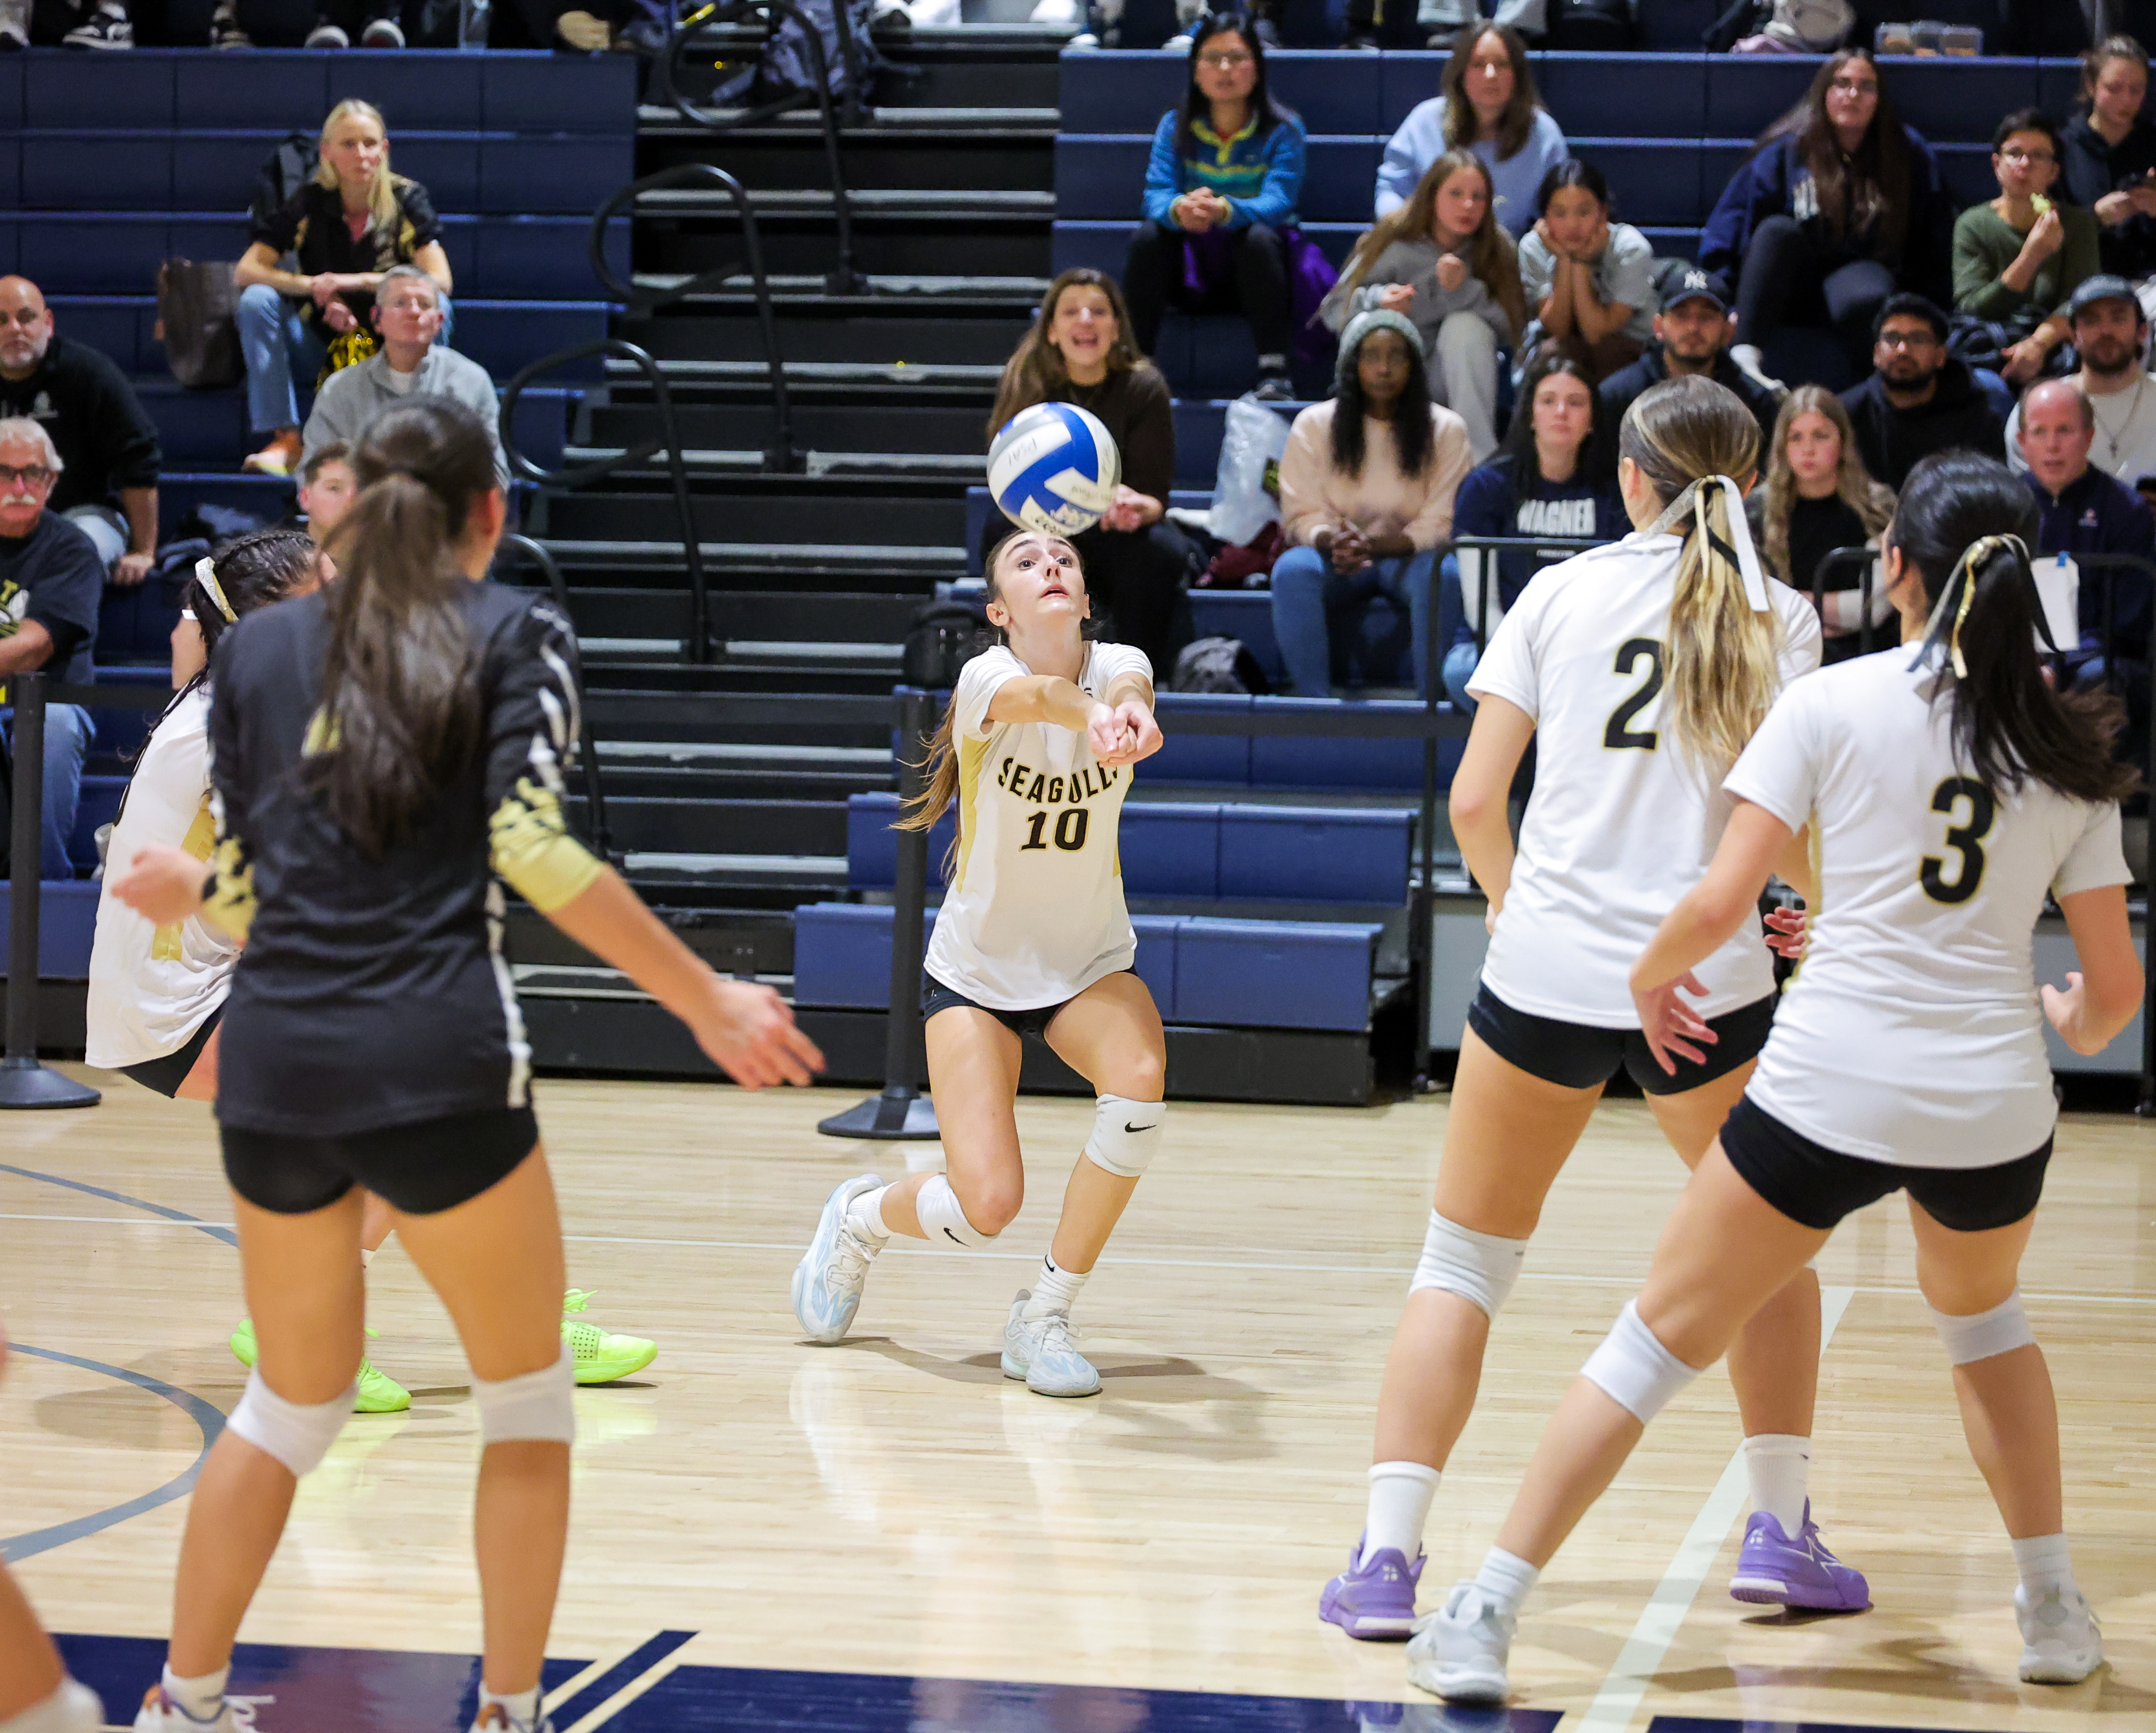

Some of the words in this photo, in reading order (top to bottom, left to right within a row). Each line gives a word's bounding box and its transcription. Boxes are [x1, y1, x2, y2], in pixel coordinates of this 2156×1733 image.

[1517, 497, 1596, 536] WAGNER
[1604, 636, 1672, 752] 2
[1019, 808, 1090, 852] 10
[1918, 776, 1996, 906] 3
